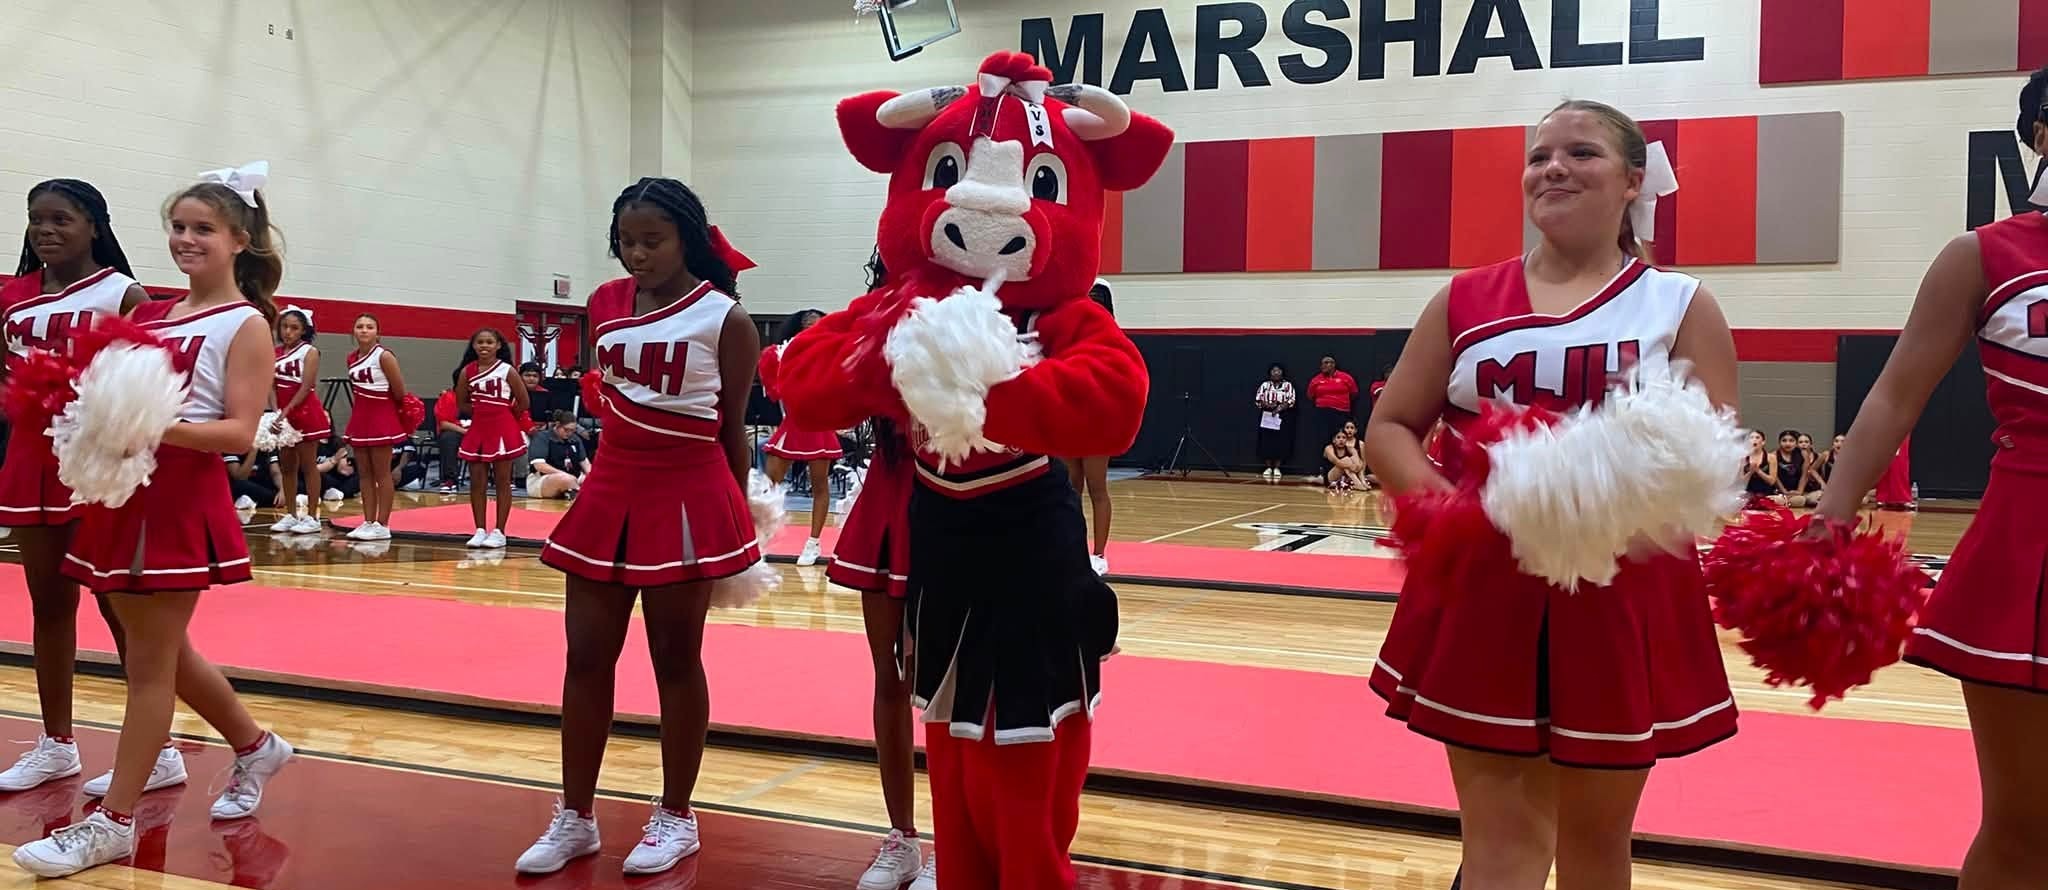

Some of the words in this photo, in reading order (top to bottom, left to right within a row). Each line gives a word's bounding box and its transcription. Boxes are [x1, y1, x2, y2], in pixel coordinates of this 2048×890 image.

[1020, 0, 1705, 95] MARSHALL
[597, 341, 689, 397] MJH
[1476, 339, 1640, 412] MJH
